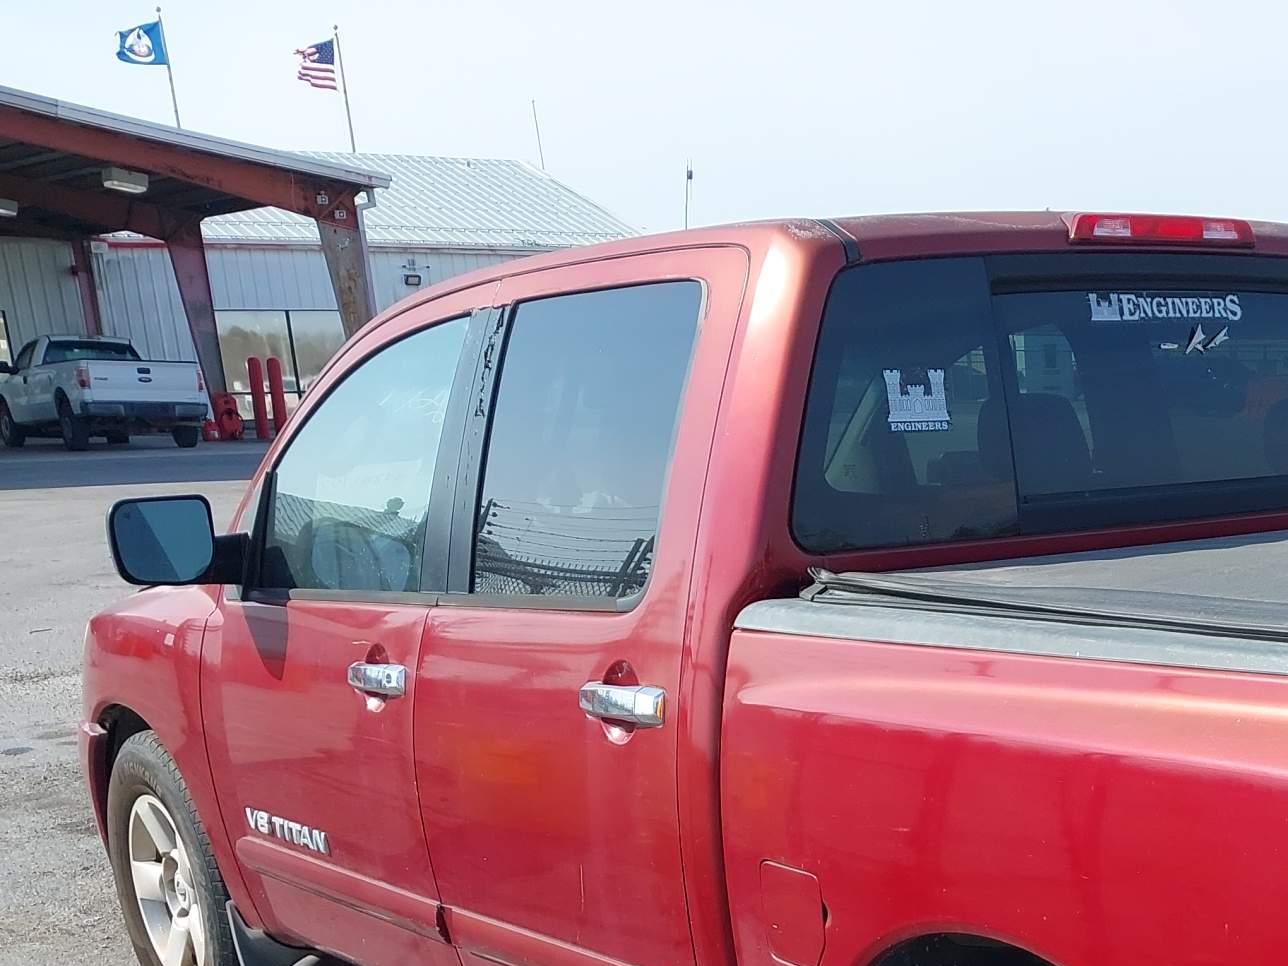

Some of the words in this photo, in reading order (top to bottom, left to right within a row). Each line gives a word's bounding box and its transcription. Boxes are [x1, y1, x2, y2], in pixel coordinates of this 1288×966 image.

[1119, 293, 1242, 321] ENGINEERS
[890, 421, 949, 432] ENGINEERS
[245, 807, 270, 834] V8
[271, 815, 330, 855] TITAN
